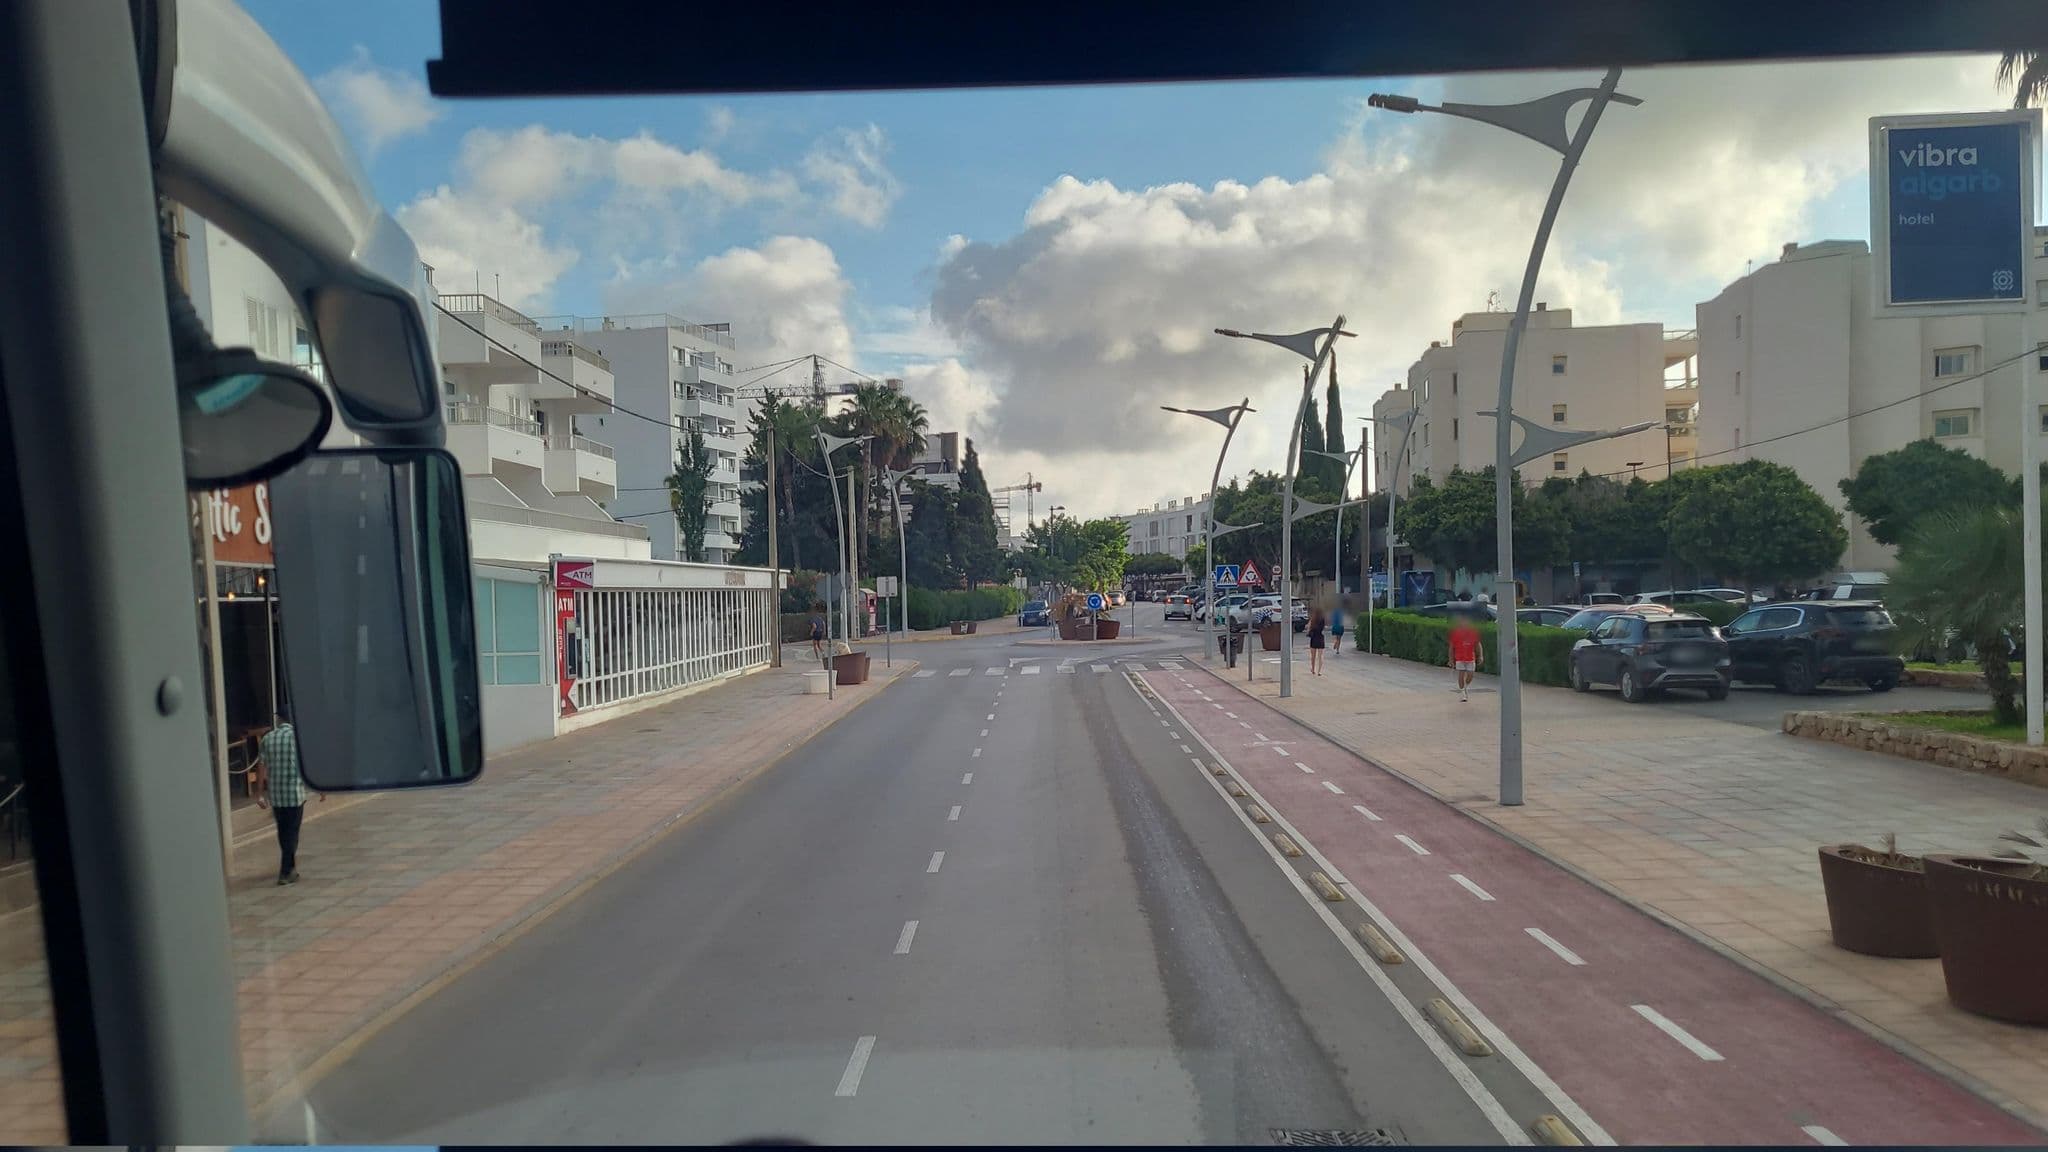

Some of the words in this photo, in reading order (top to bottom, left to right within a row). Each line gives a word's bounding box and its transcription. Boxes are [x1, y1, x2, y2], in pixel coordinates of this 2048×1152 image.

[1899, 143, 1978, 167] vibra
[1899, 169, 2002, 201] algarb
[1899, 212, 1935, 225] hotel
[572, 571, 592, 579] ATM
[558, 597, 574, 613] ATM
